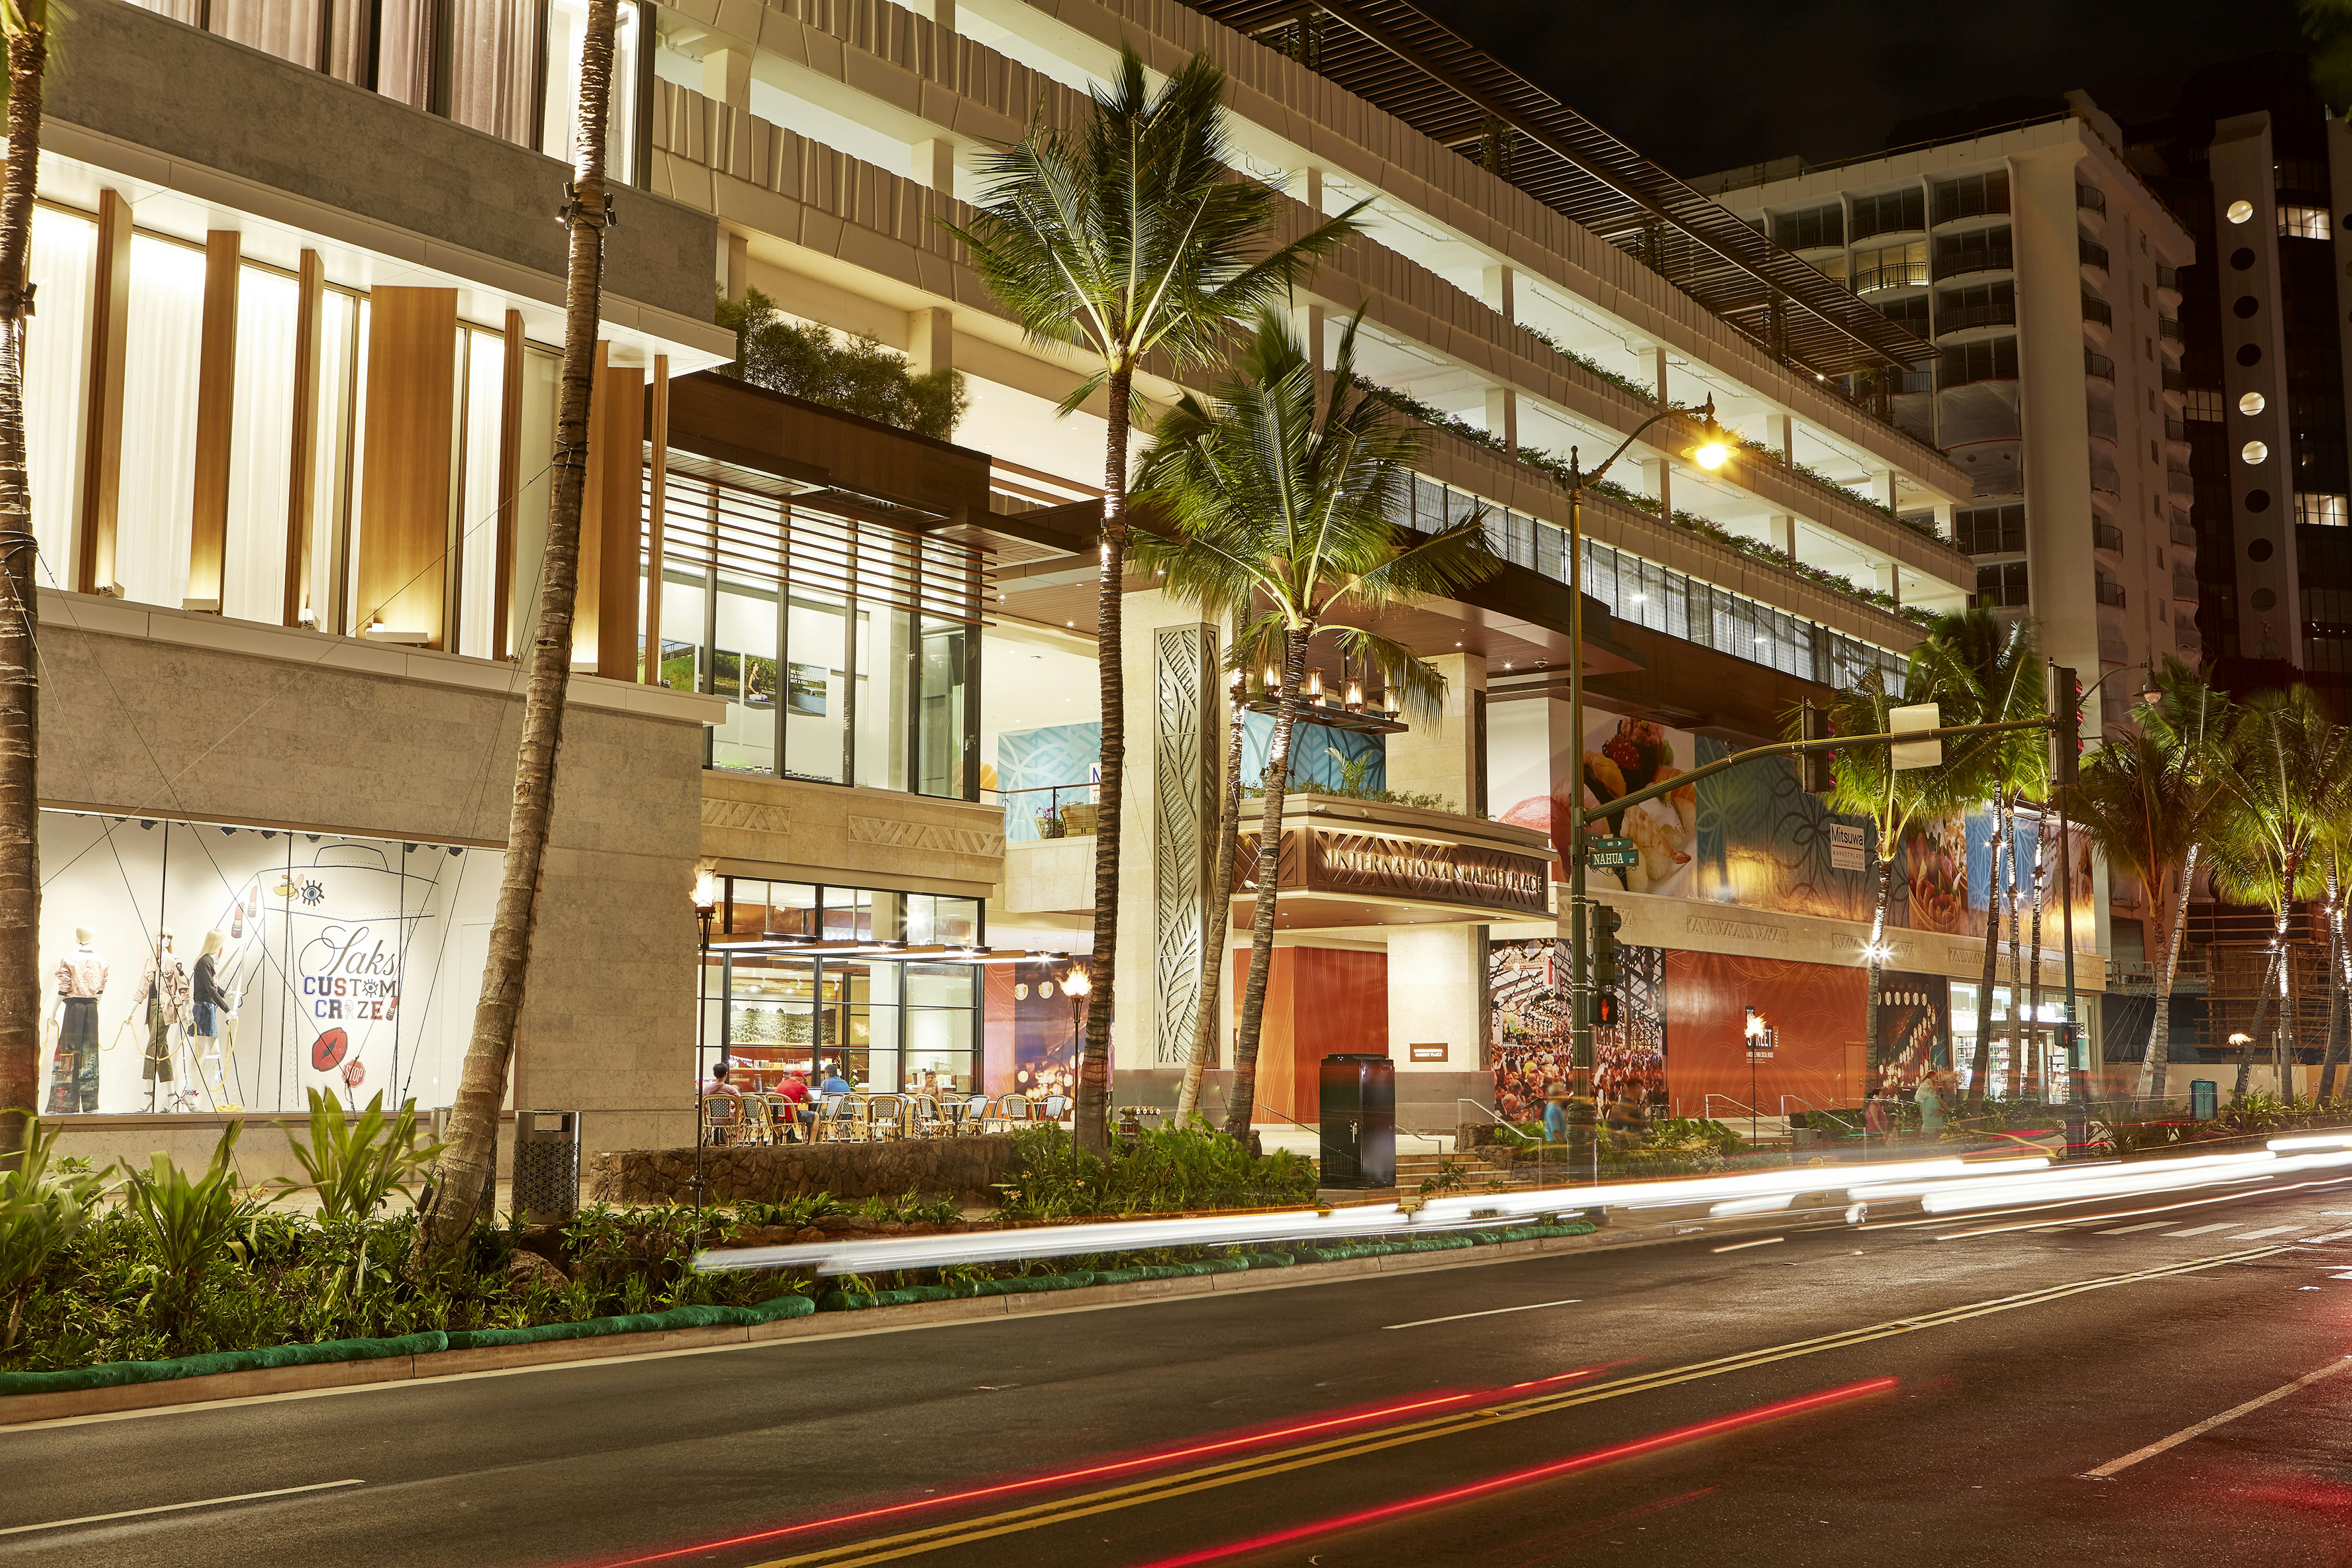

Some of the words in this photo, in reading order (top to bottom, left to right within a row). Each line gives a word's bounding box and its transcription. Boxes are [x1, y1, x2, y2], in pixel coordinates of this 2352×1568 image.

[1831, 826, 1863, 846] Mitsuwa
[1832, 850, 1864, 860] MARKETPLACE
[1331, 849, 1456, 880] INTERNATIONAL
[1461, 864, 1509, 887] MARKET
[1512, 872, 1542, 893] PLACE
[299, 926, 396, 976] Saks
[303, 975, 397, 998] CUSTOM
[1747, 1029, 1772, 1047] SREET
[345, 1064, 363, 1083] STOP
